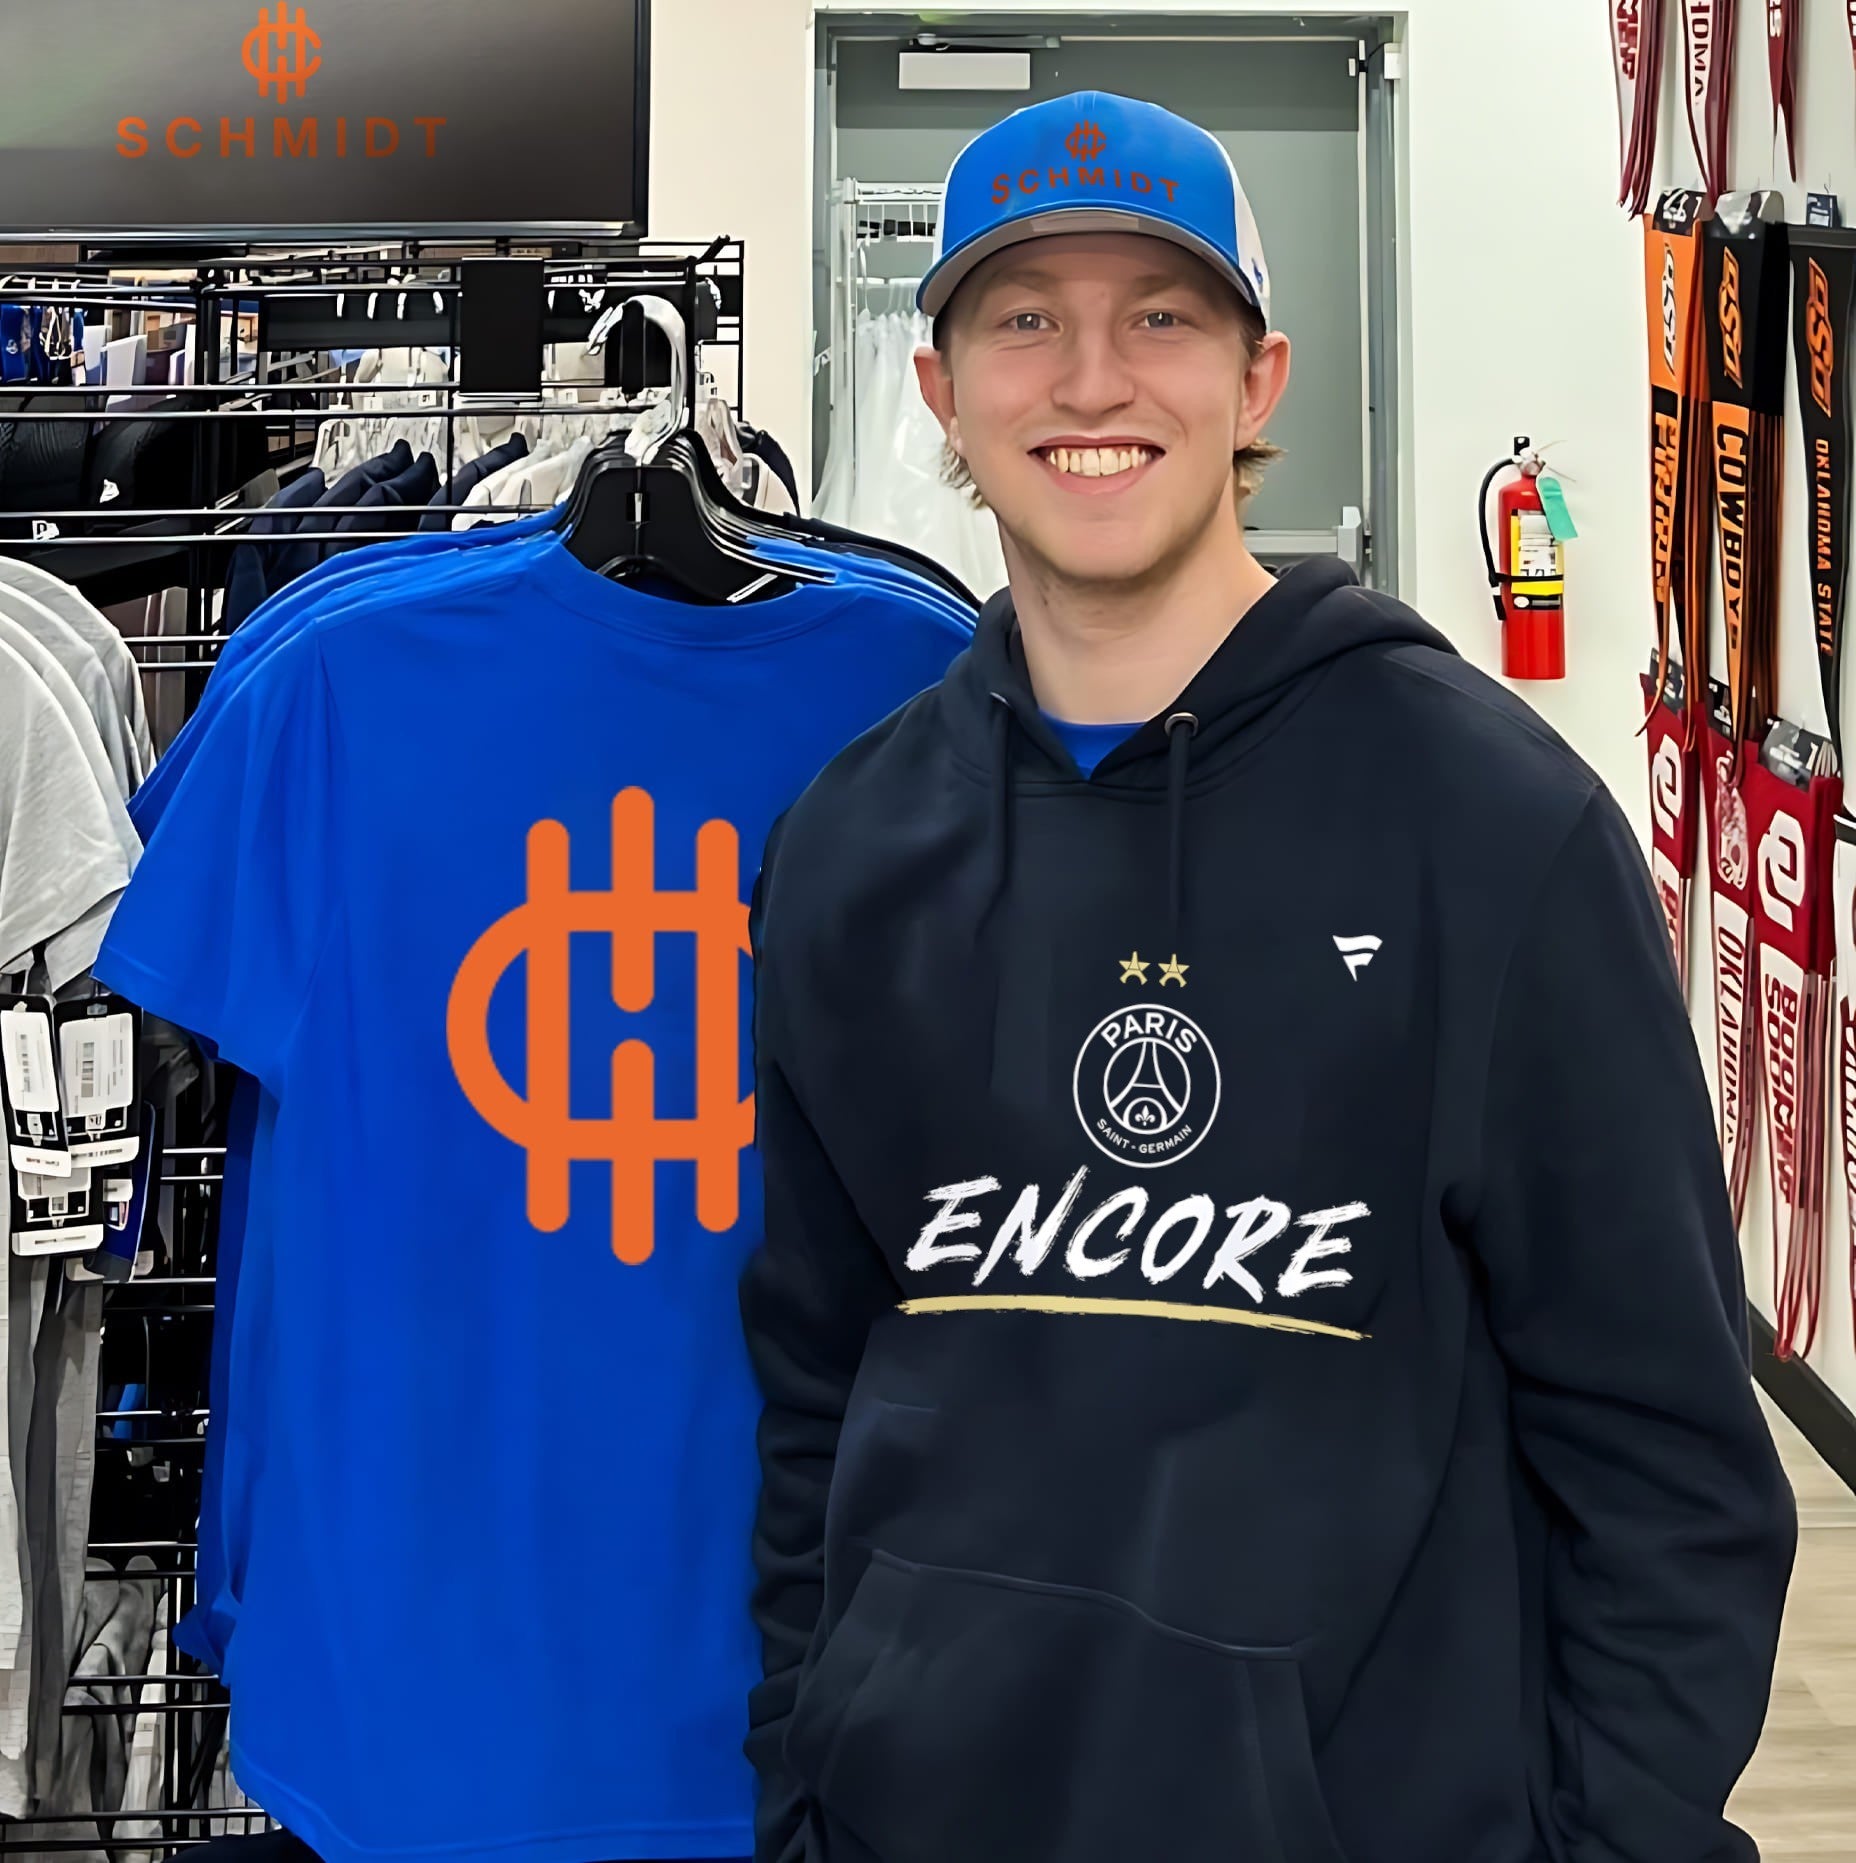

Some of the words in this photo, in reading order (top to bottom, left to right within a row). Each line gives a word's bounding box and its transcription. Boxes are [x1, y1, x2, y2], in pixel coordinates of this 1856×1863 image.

[115, 116, 448, 158] SCHMIDT
[991, 167, 1179, 204] SCHMIDT
[1815, 439, 1832, 570] OKLAHOMA
[1101, 1012, 1198, 1053] PARIS
[1096, 1118, 1130, 1150] SAINT
[1139, 1124, 1193, 1154] GERMAIN
[904, 1165, 1371, 1303] ENCORE
